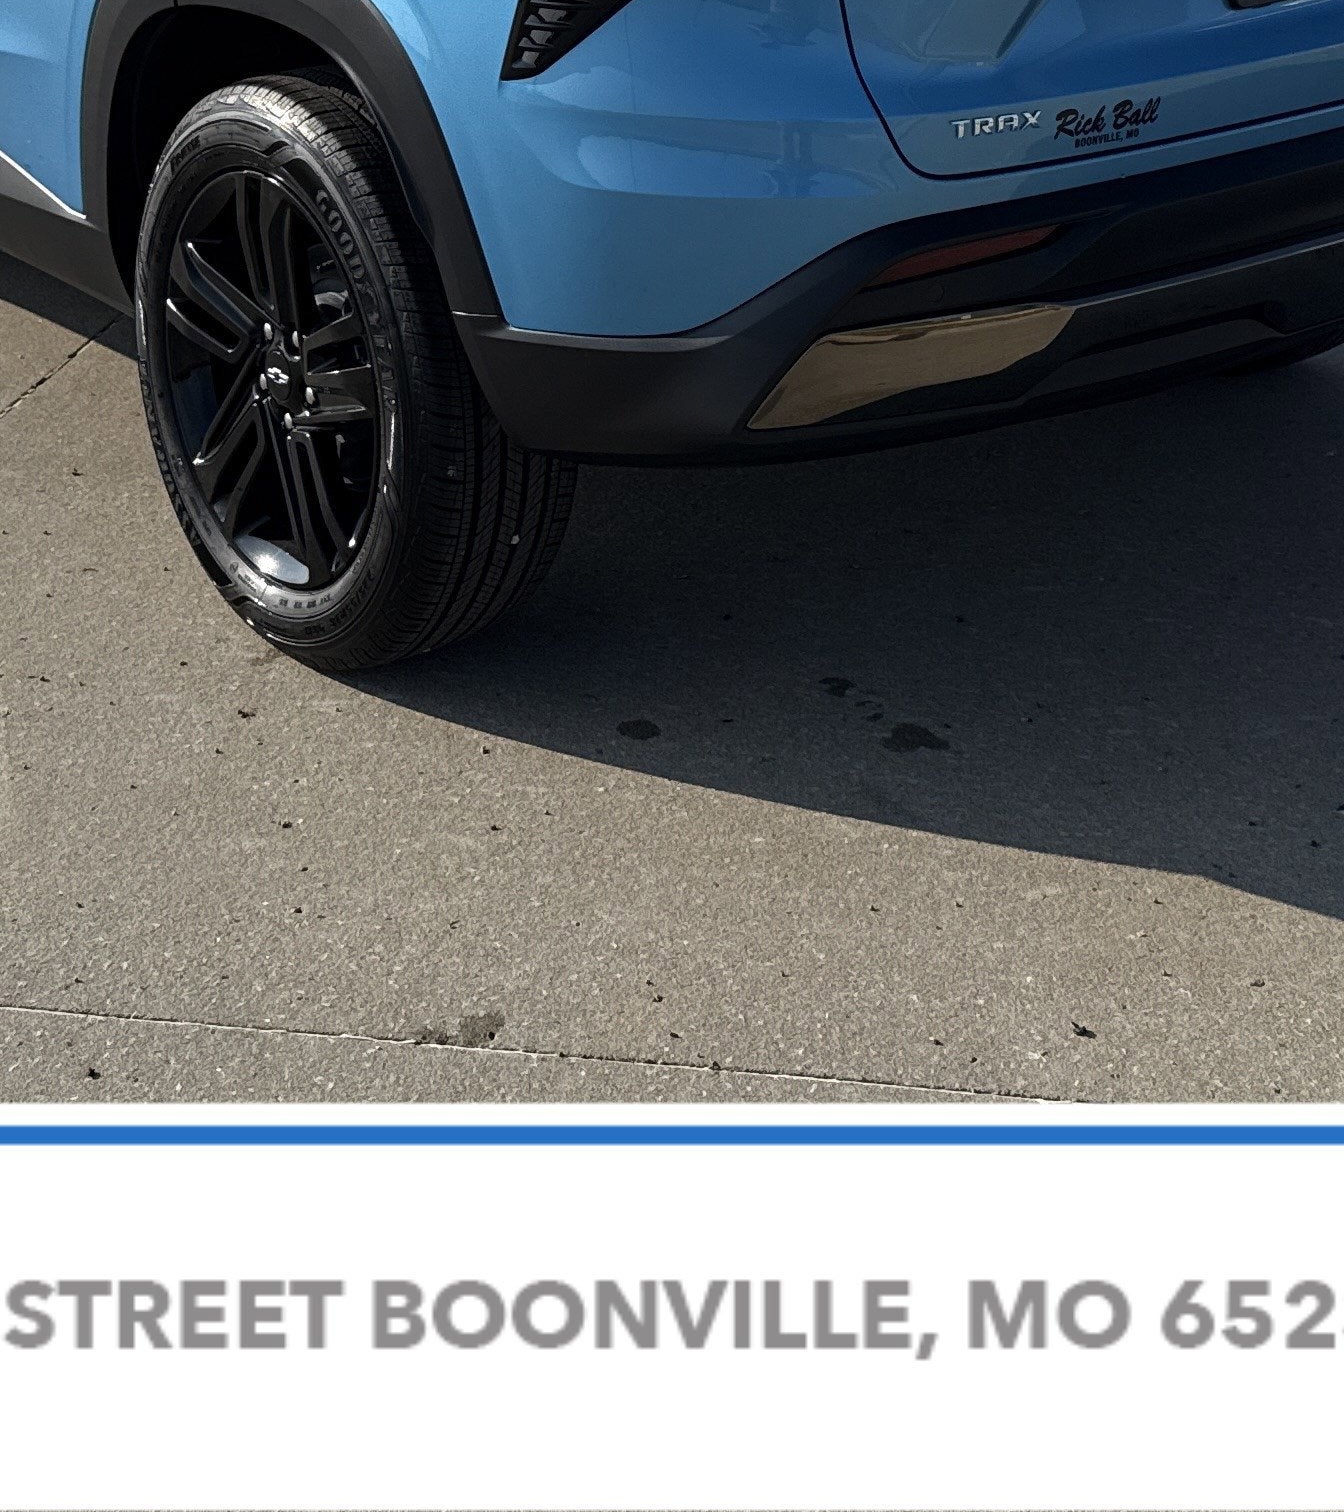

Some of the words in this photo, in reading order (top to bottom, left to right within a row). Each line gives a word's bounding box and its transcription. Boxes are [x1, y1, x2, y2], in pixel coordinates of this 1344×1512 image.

[951, 111, 1041, 139] TRAX
[1054, 105, 1106, 140] Rick
[1113, 97, 1161, 130] Ball
[1075, 133, 1123, 148] BOONVILLE,
[1126, 129, 1140, 139] MO
